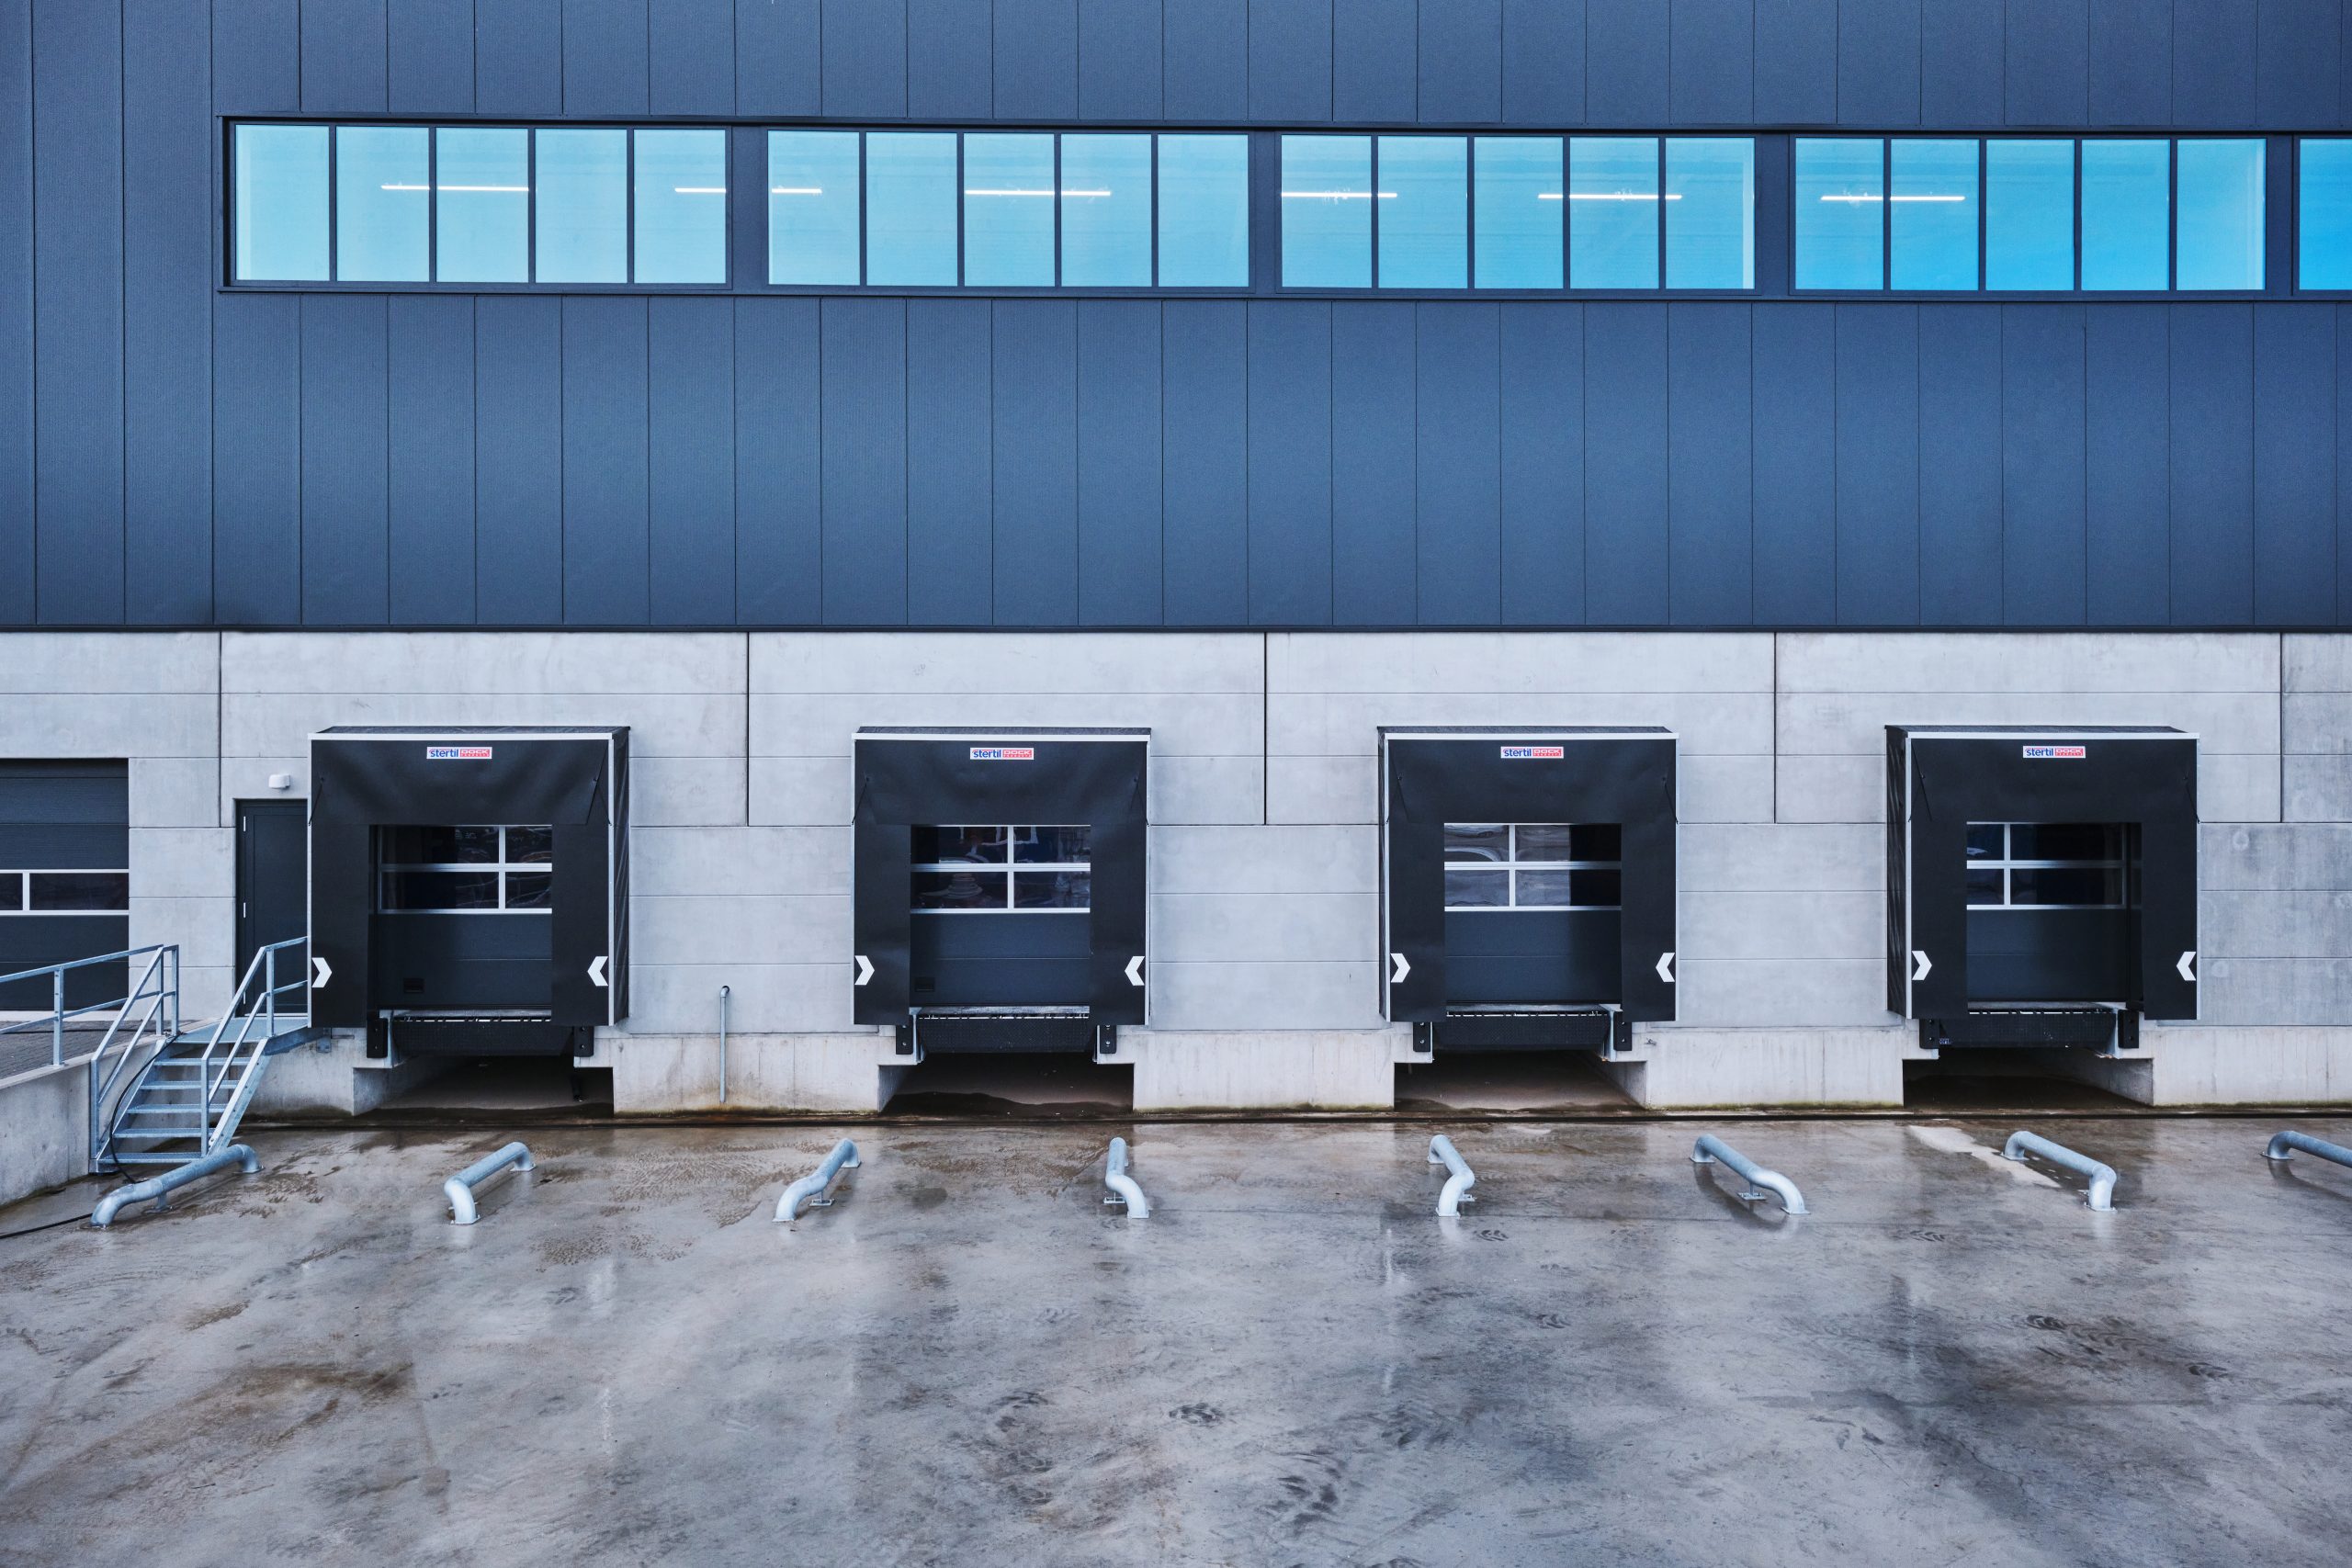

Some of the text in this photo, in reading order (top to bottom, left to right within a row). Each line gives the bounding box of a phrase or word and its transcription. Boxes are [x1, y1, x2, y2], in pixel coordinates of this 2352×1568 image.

[430, 749, 459, 758] stertil
[973, 749, 1001, 758] stertil
[1504, 749, 1532, 757] stertil
[2026, 748, 2053, 757] stertil
